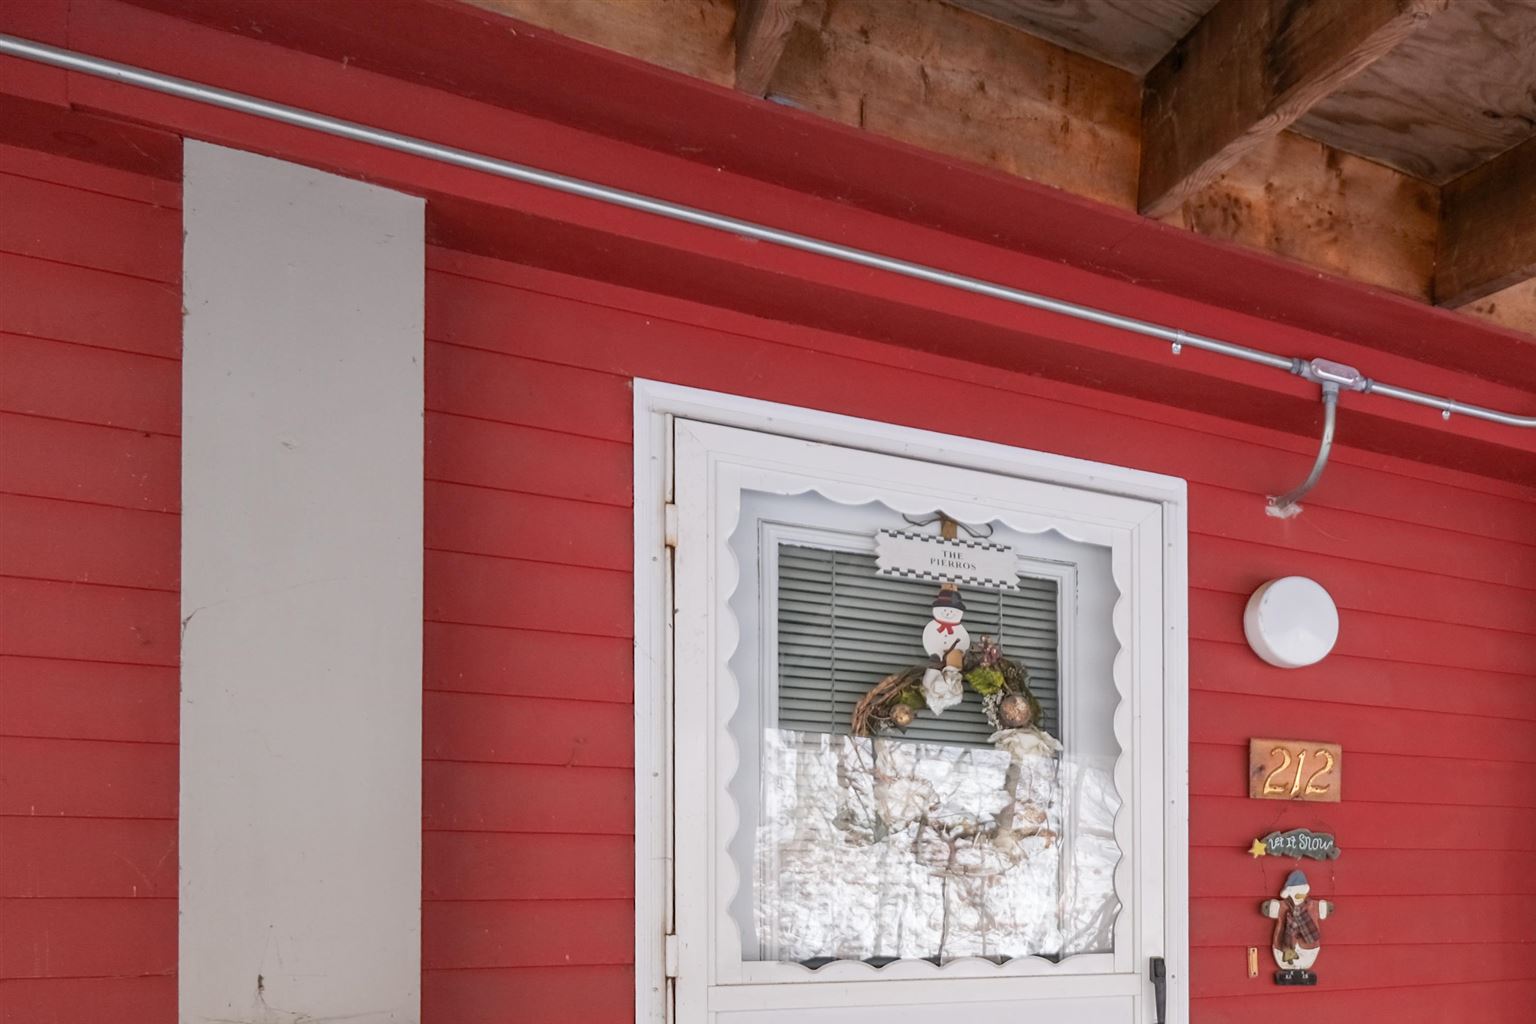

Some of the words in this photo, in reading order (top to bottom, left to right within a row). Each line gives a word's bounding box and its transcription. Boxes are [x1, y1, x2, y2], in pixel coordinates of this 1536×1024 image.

[943, 551, 964, 559] THE
[930, 558, 977, 570] PIERROS
[1263, 746, 1334, 795] 212
